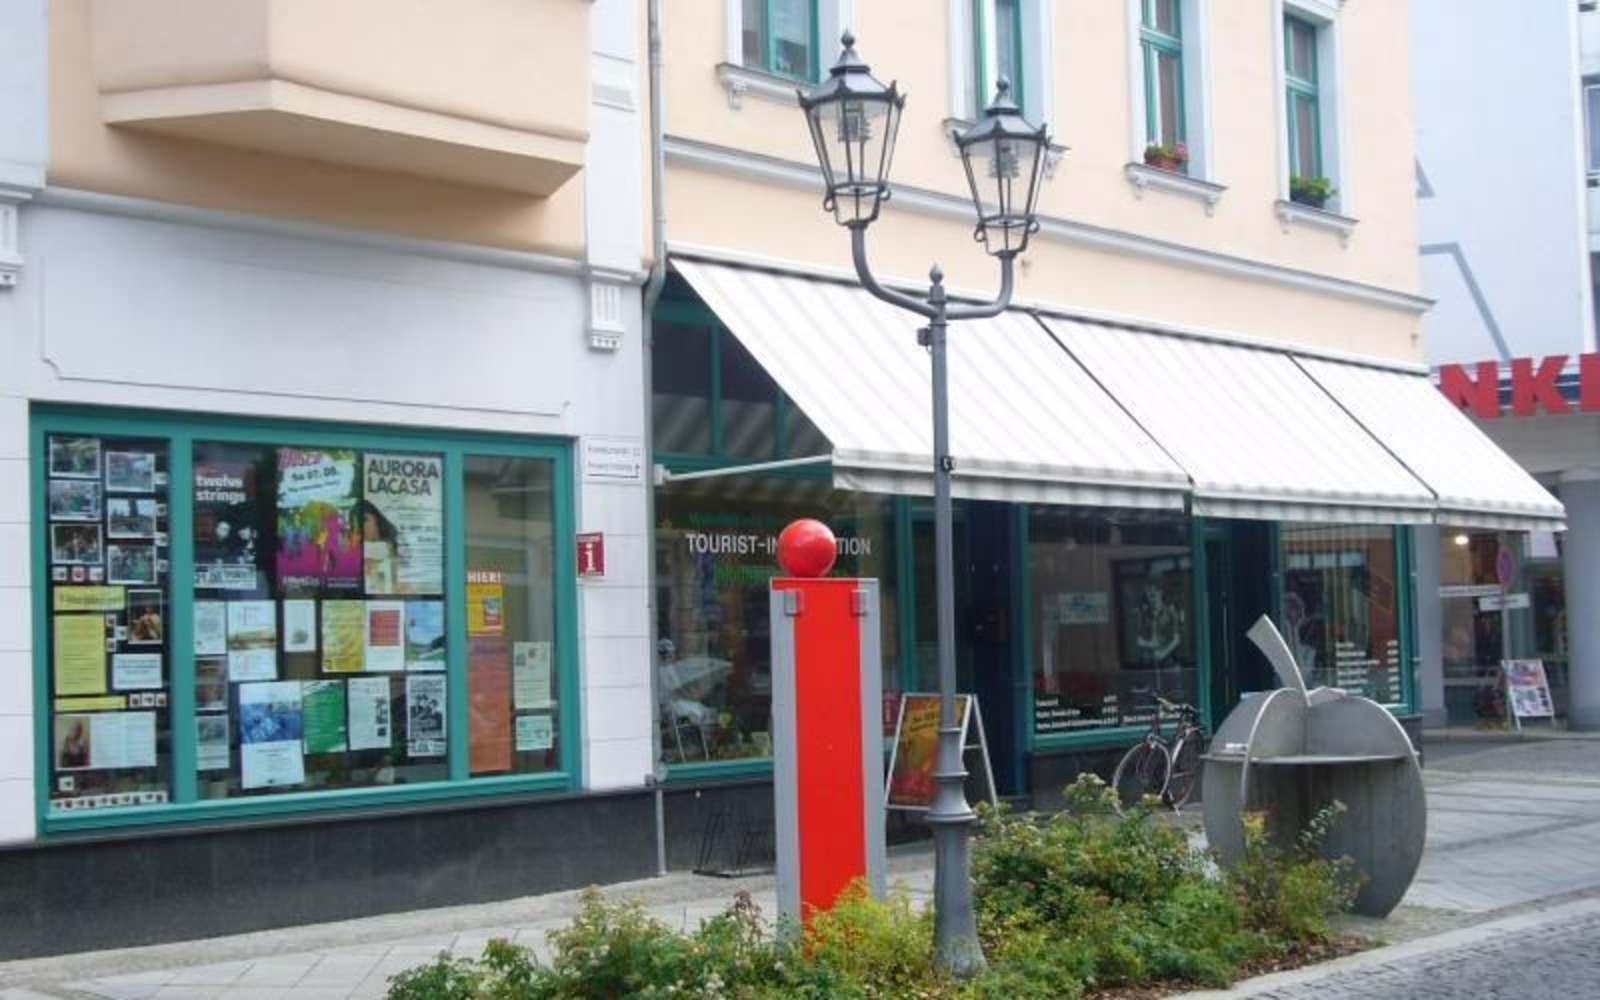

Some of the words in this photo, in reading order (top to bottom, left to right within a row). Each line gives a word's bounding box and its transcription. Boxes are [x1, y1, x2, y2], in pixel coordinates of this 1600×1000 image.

[367, 459, 439, 478] AURORA
[196, 474, 244, 488] twelve
[368, 477, 432, 496] LACASA
[196, 490, 247, 505] strings
[685, 533, 871, 555] TOURIST-INTION
[467, 571, 501, 583] HIER!
